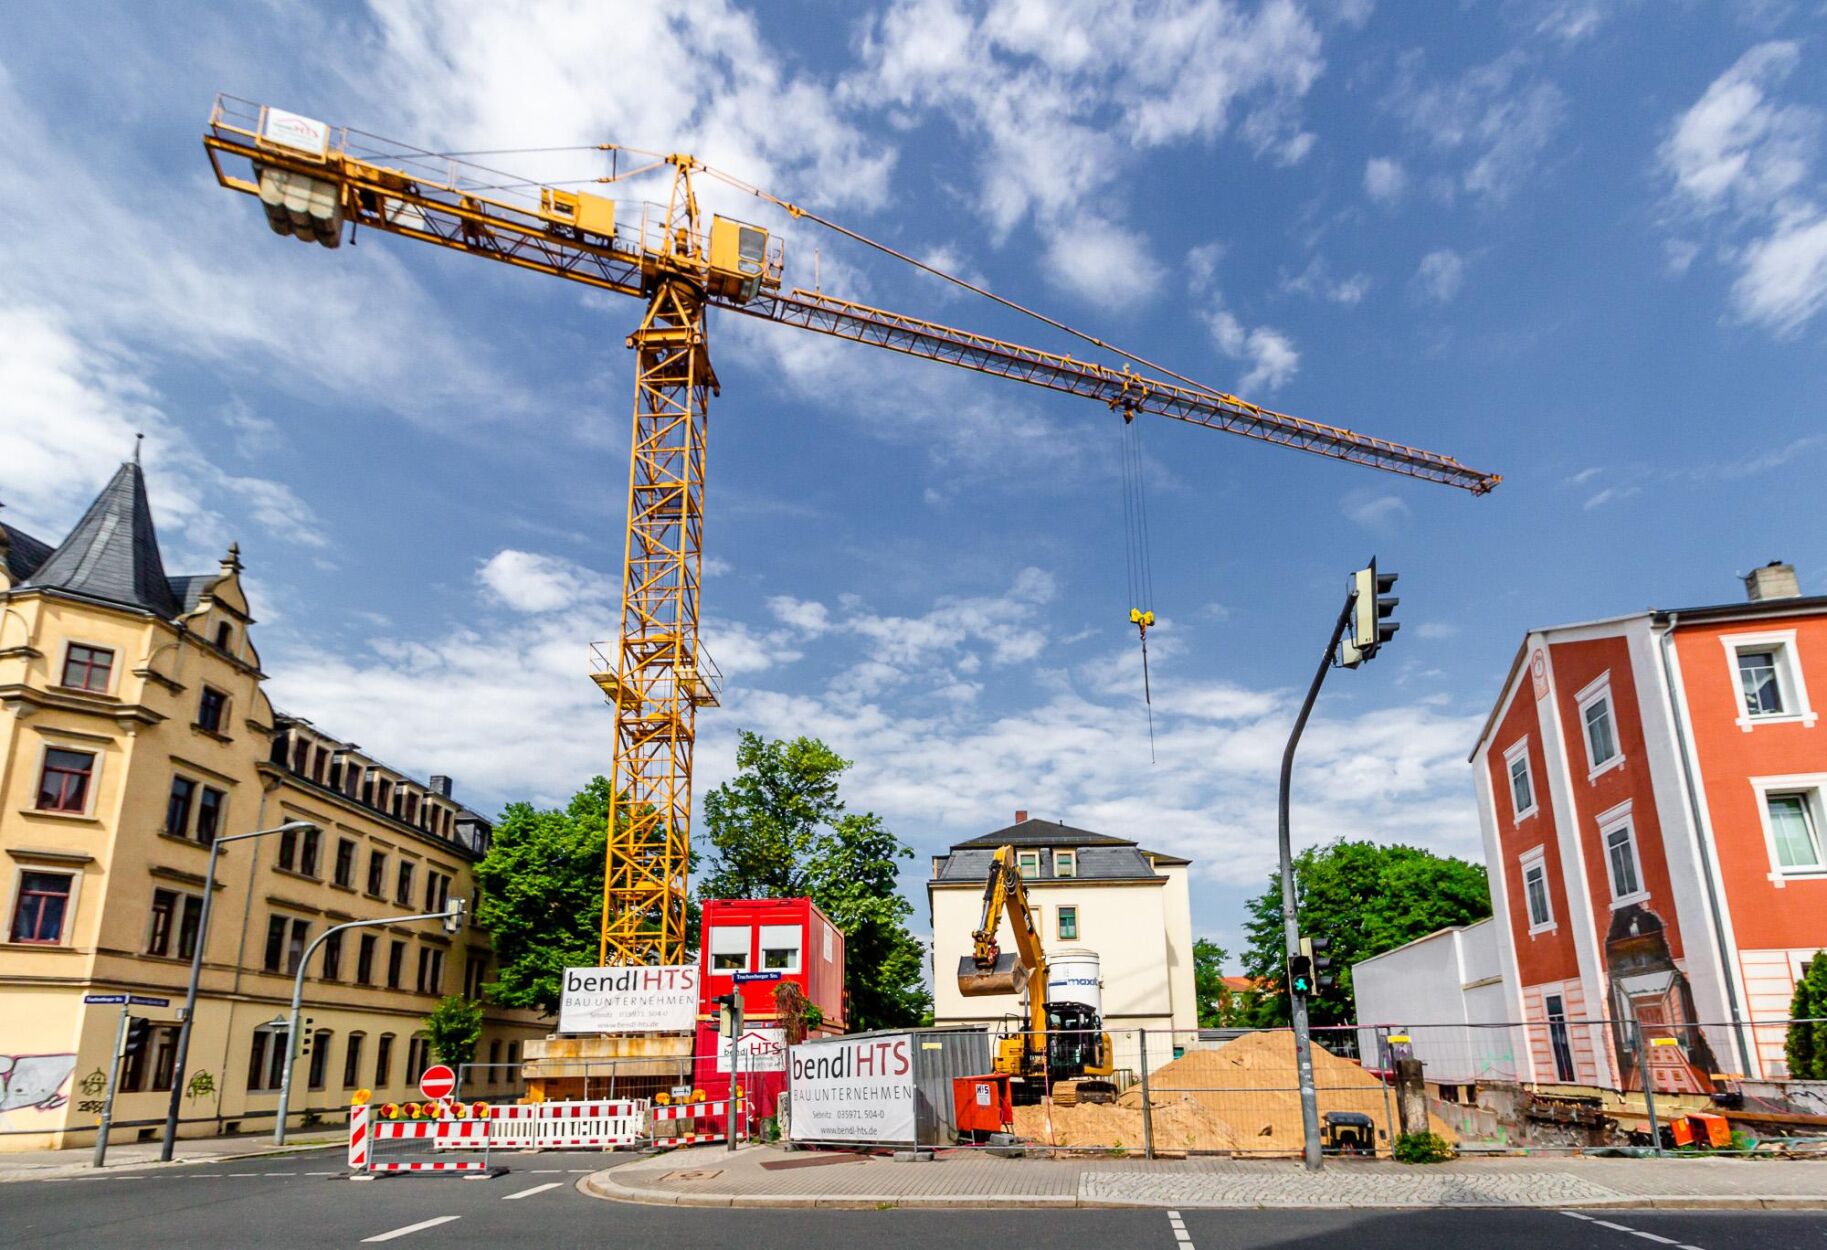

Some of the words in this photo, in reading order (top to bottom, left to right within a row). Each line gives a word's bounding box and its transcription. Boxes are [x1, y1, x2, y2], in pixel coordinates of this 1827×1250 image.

[568, 970, 637, 992] bendl
[643, 968, 694, 990] HTS
[1067, 977, 1098, 986] maxit
[750, 1041, 780, 1056] HTS
[792, 1046, 852, 1080] bendl
[856, 1041, 910, 1077] HTS
[864, 1109, 885, 1119] 504-0
[820, 1125, 878, 1136] www.bendl-hts.de
